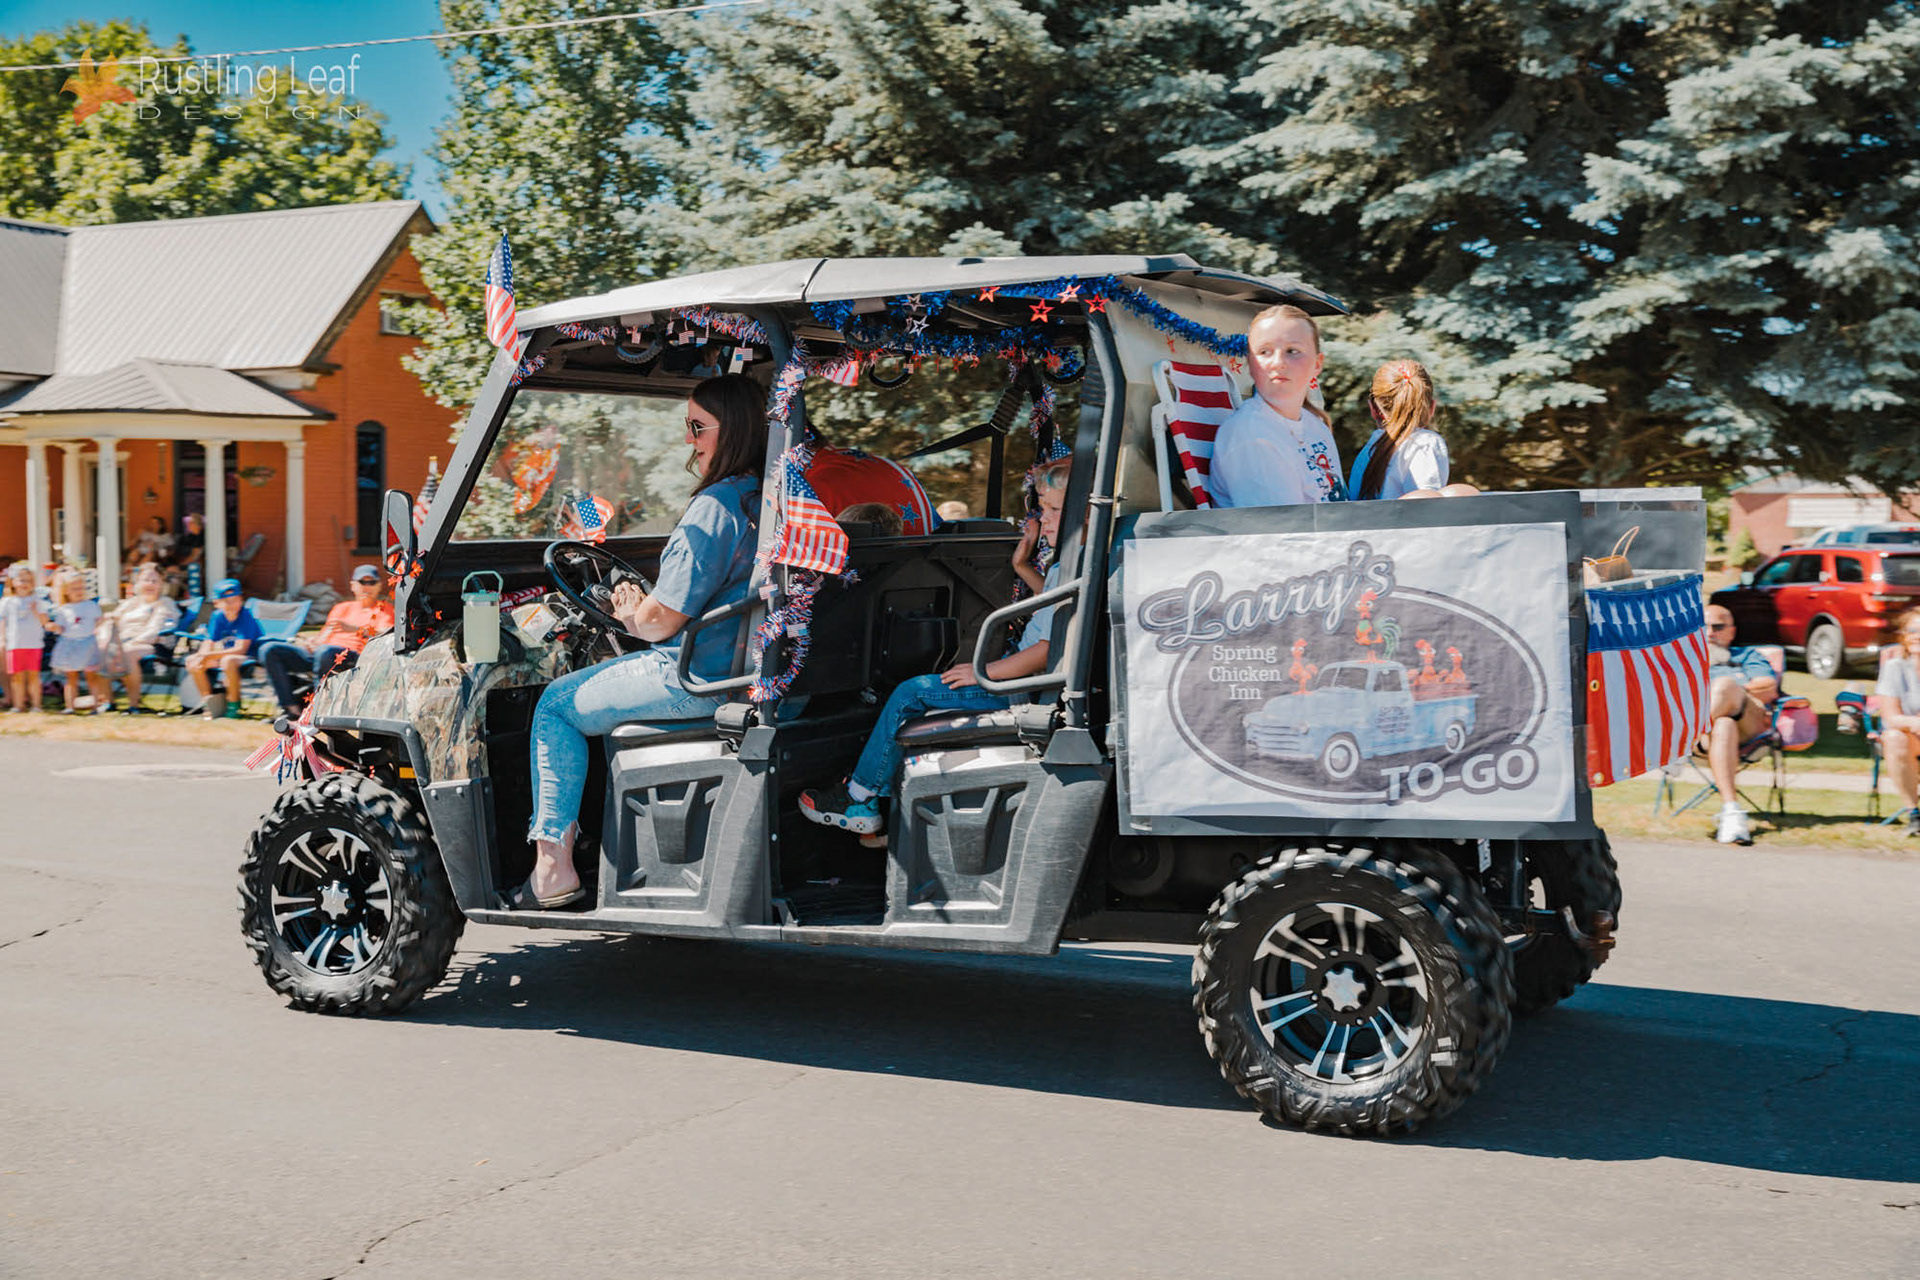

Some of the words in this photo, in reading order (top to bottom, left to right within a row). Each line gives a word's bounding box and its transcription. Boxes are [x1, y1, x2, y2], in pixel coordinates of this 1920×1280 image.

[1140, 541, 1394, 650] Larry's
[1212, 644, 1278, 665] Spring
[1208, 665, 1283, 682] Chicken
[1228, 683, 1263, 700] Inn
[1380, 748, 1535, 801] TO-GO
